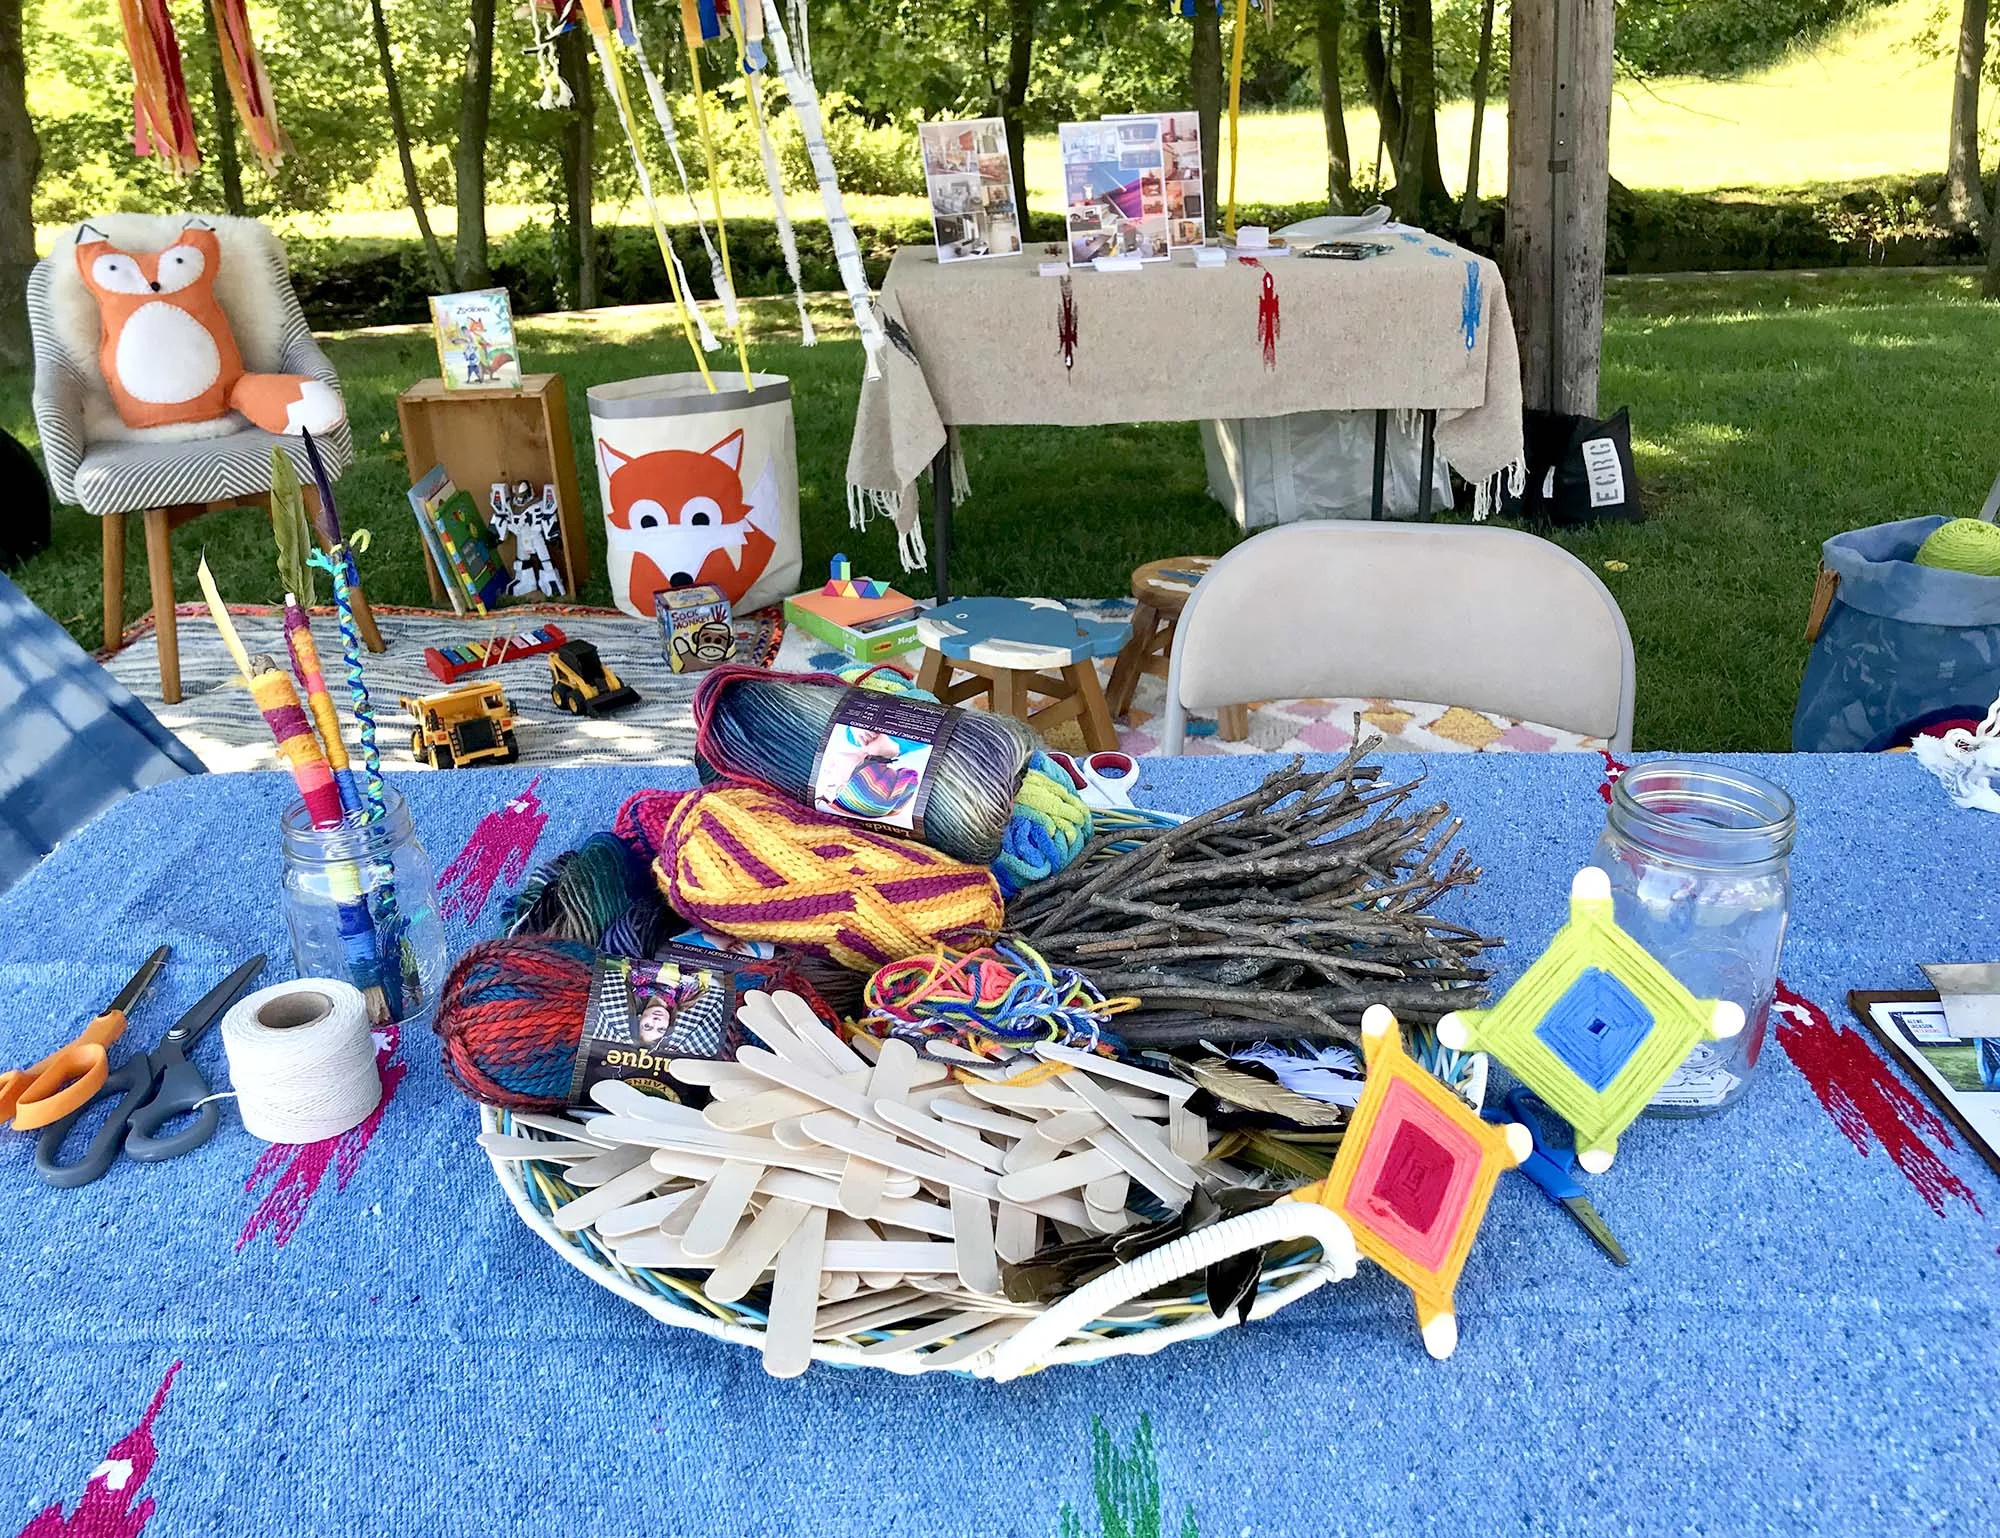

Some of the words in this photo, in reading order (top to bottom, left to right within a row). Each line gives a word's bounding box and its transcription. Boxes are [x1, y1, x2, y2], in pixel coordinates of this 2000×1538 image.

[1589, 442, 1619, 503] ECRG
[673, 614, 710, 631] MONKEY
[861, 822, 911, 838] Lands
[606, 1047, 671, 1077] nique
